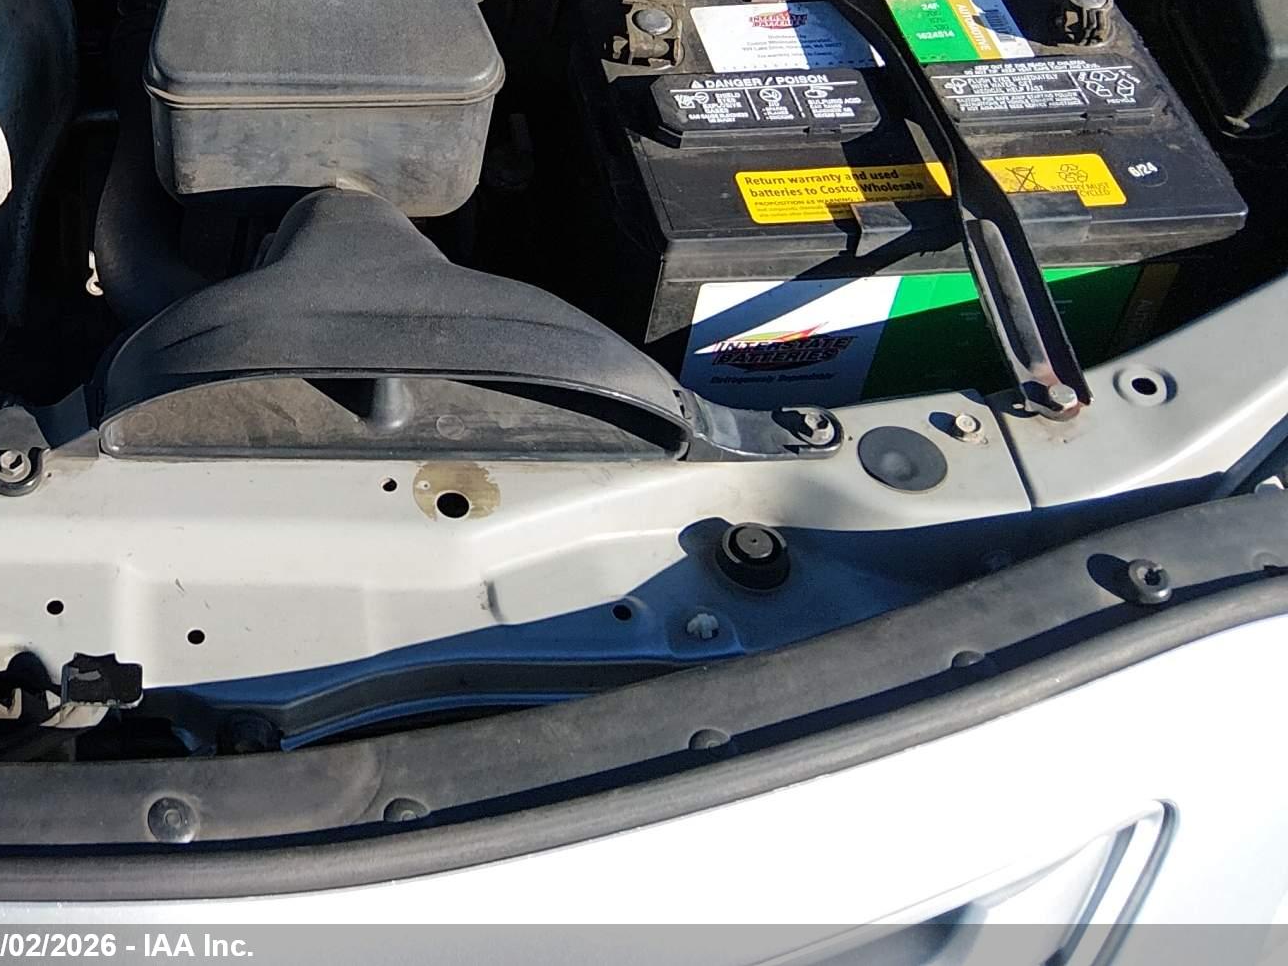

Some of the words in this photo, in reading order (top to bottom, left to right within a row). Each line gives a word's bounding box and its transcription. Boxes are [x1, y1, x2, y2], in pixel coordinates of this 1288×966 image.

[748, 13, 808, 23] INTERSTATE
[704, 79, 762, 89] DANGER
[777, 74, 829, 85] POISON
[744, 175, 785, 186] Return
[789, 173, 842, 186] warranty
[845, 170, 867, 181] and
[870, 169, 900, 180] used
[1127, 161, 1159, 178] 6/24
[749, 186, 803, 198] batteries
[805, 186, 818, 196] to
[820, 185, 858, 195] Costco
[859, 180, 925, 193] Wholesale
[1079, 188, 1111, 197] CYCLED
[1084, 181, 1110, 190] MUST
[715, 335, 858, 353] INTERSTATE
[712, 347, 842, 366] BATTERIES
